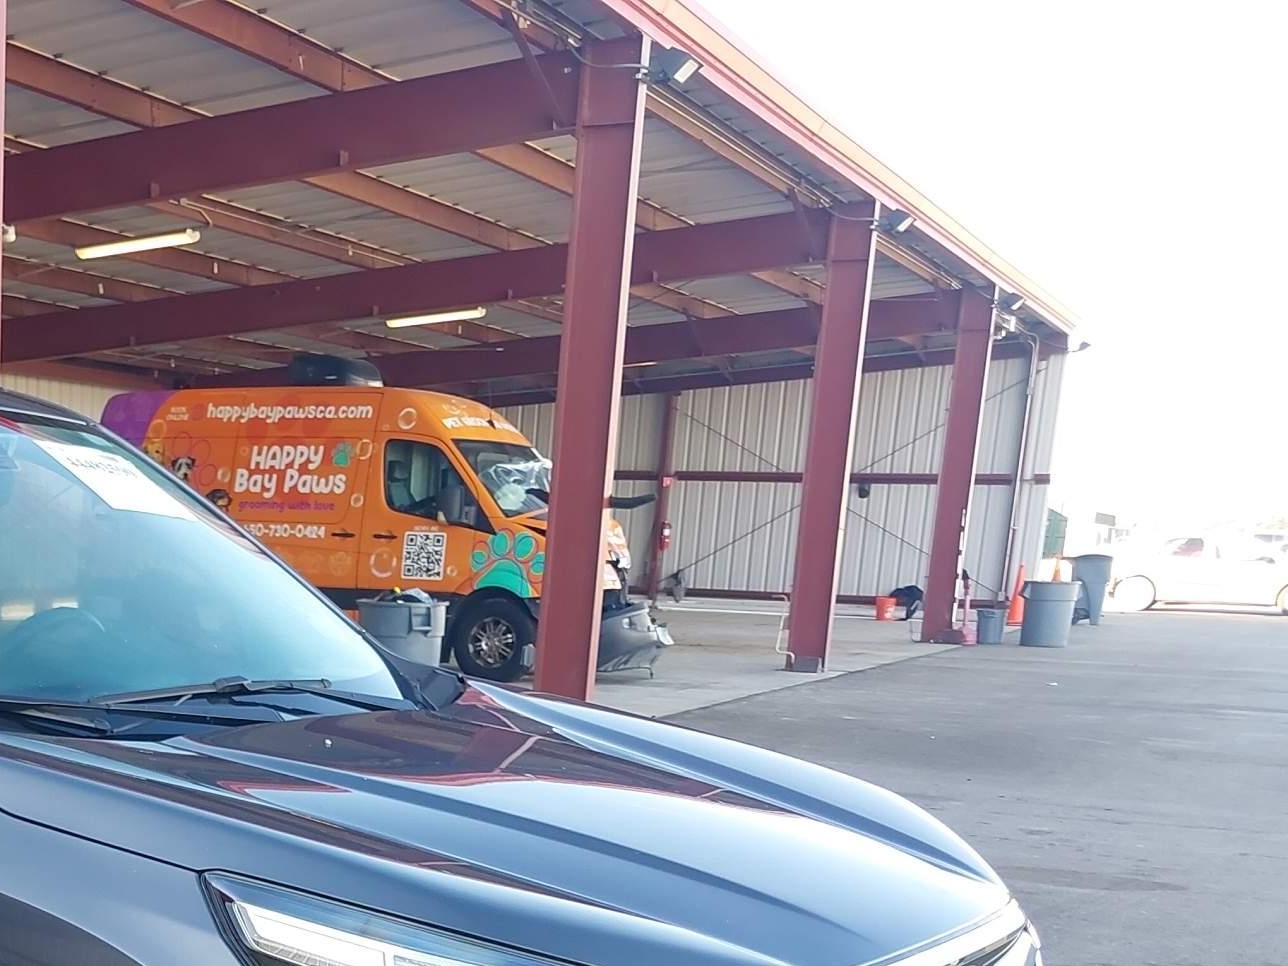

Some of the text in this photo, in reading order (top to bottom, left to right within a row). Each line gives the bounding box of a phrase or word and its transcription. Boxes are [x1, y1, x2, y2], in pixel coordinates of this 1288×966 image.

[207, 402, 374, 424] happybaypawsca.com
[249, 444, 325, 471] HAPPY
[233, 468, 347, 498] Bay Paws
[238, 500, 336, 513] grooming with love
